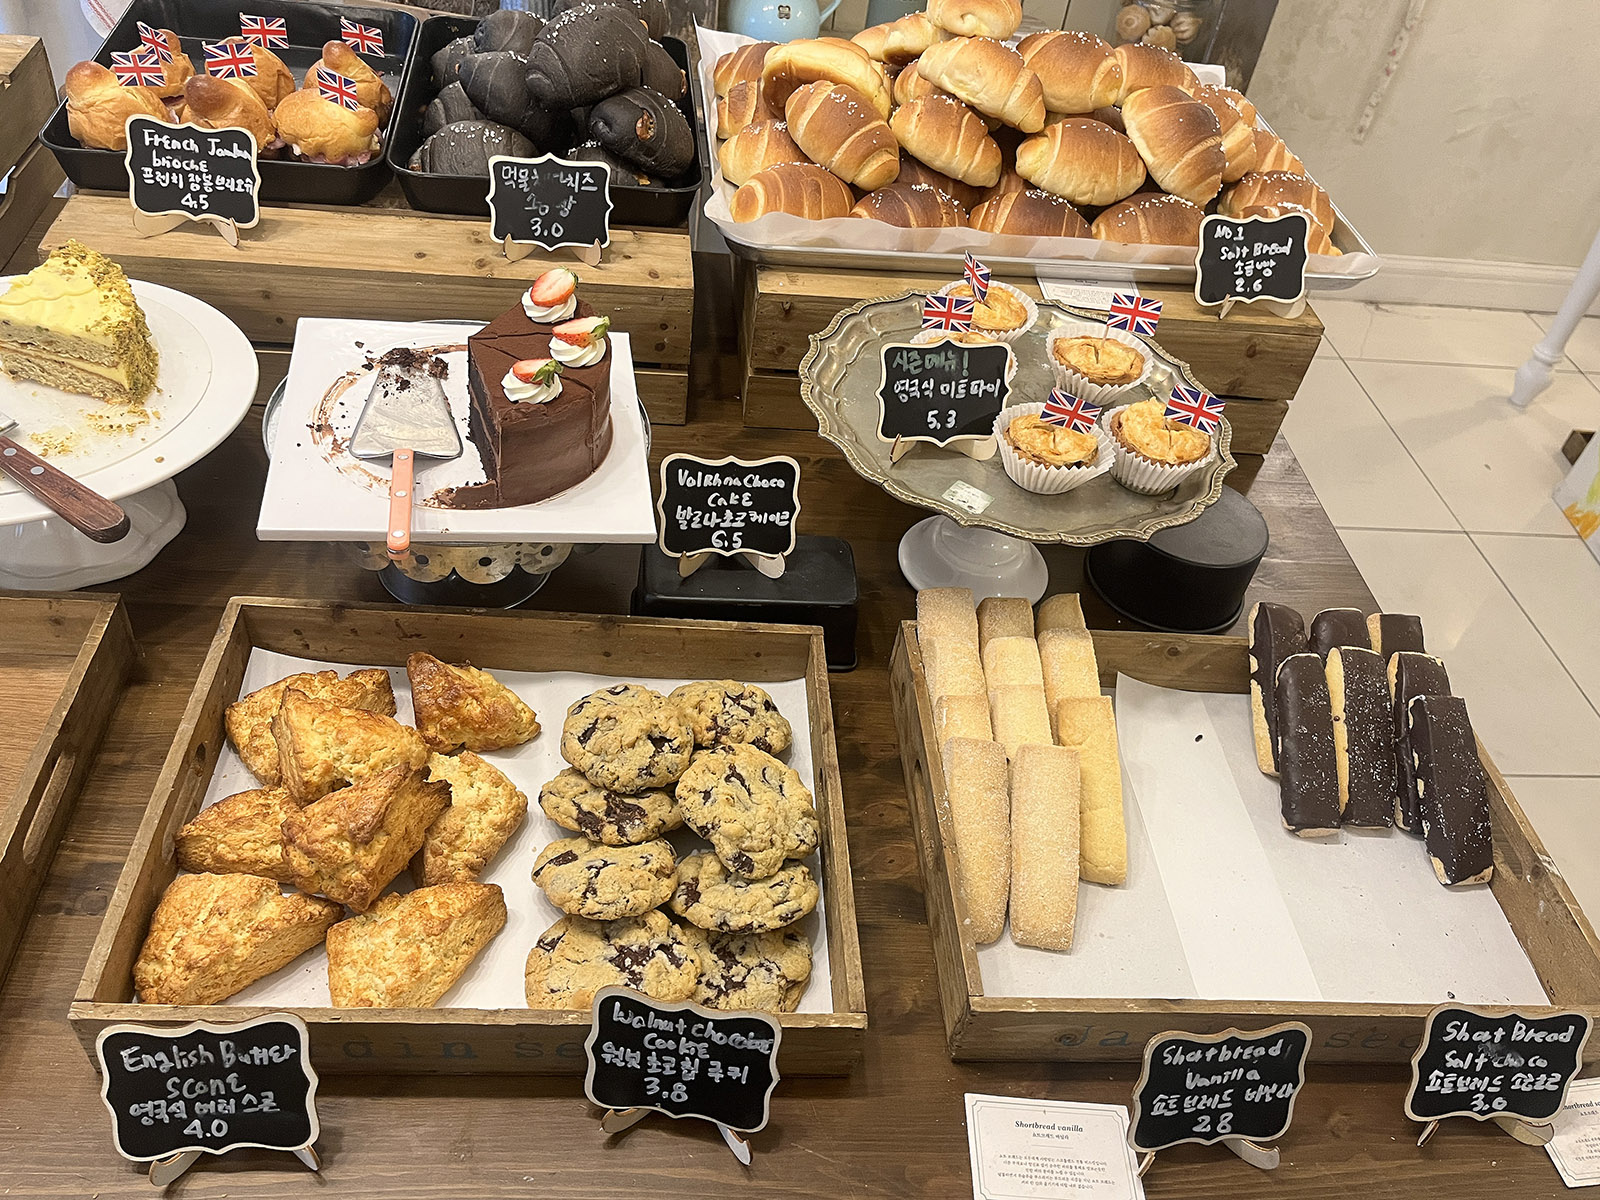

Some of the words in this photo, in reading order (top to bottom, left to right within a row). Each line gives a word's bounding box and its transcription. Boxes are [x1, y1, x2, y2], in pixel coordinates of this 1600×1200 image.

[142, 129, 199, 153] French
[530, 217, 564, 238] 3.0
[1233, 259, 1276, 277] 소금빵
[893, 378, 934, 403] 영국식
[612, 1001, 687, 1035] Walnut
[1511, 1020, 1575, 1044] Bread
[120, 1044, 215, 1073] English
[219, 1040, 297, 1068] Butter
[1444, 1050, 1488, 1072] Salt
[643, 1076, 689, 1103] 3.8
[183, 1118, 229, 1139] 4.0
[1015, 1120, 1056, 1131] Shortbread
[1057, 1124, 1084, 1133] vanilla
